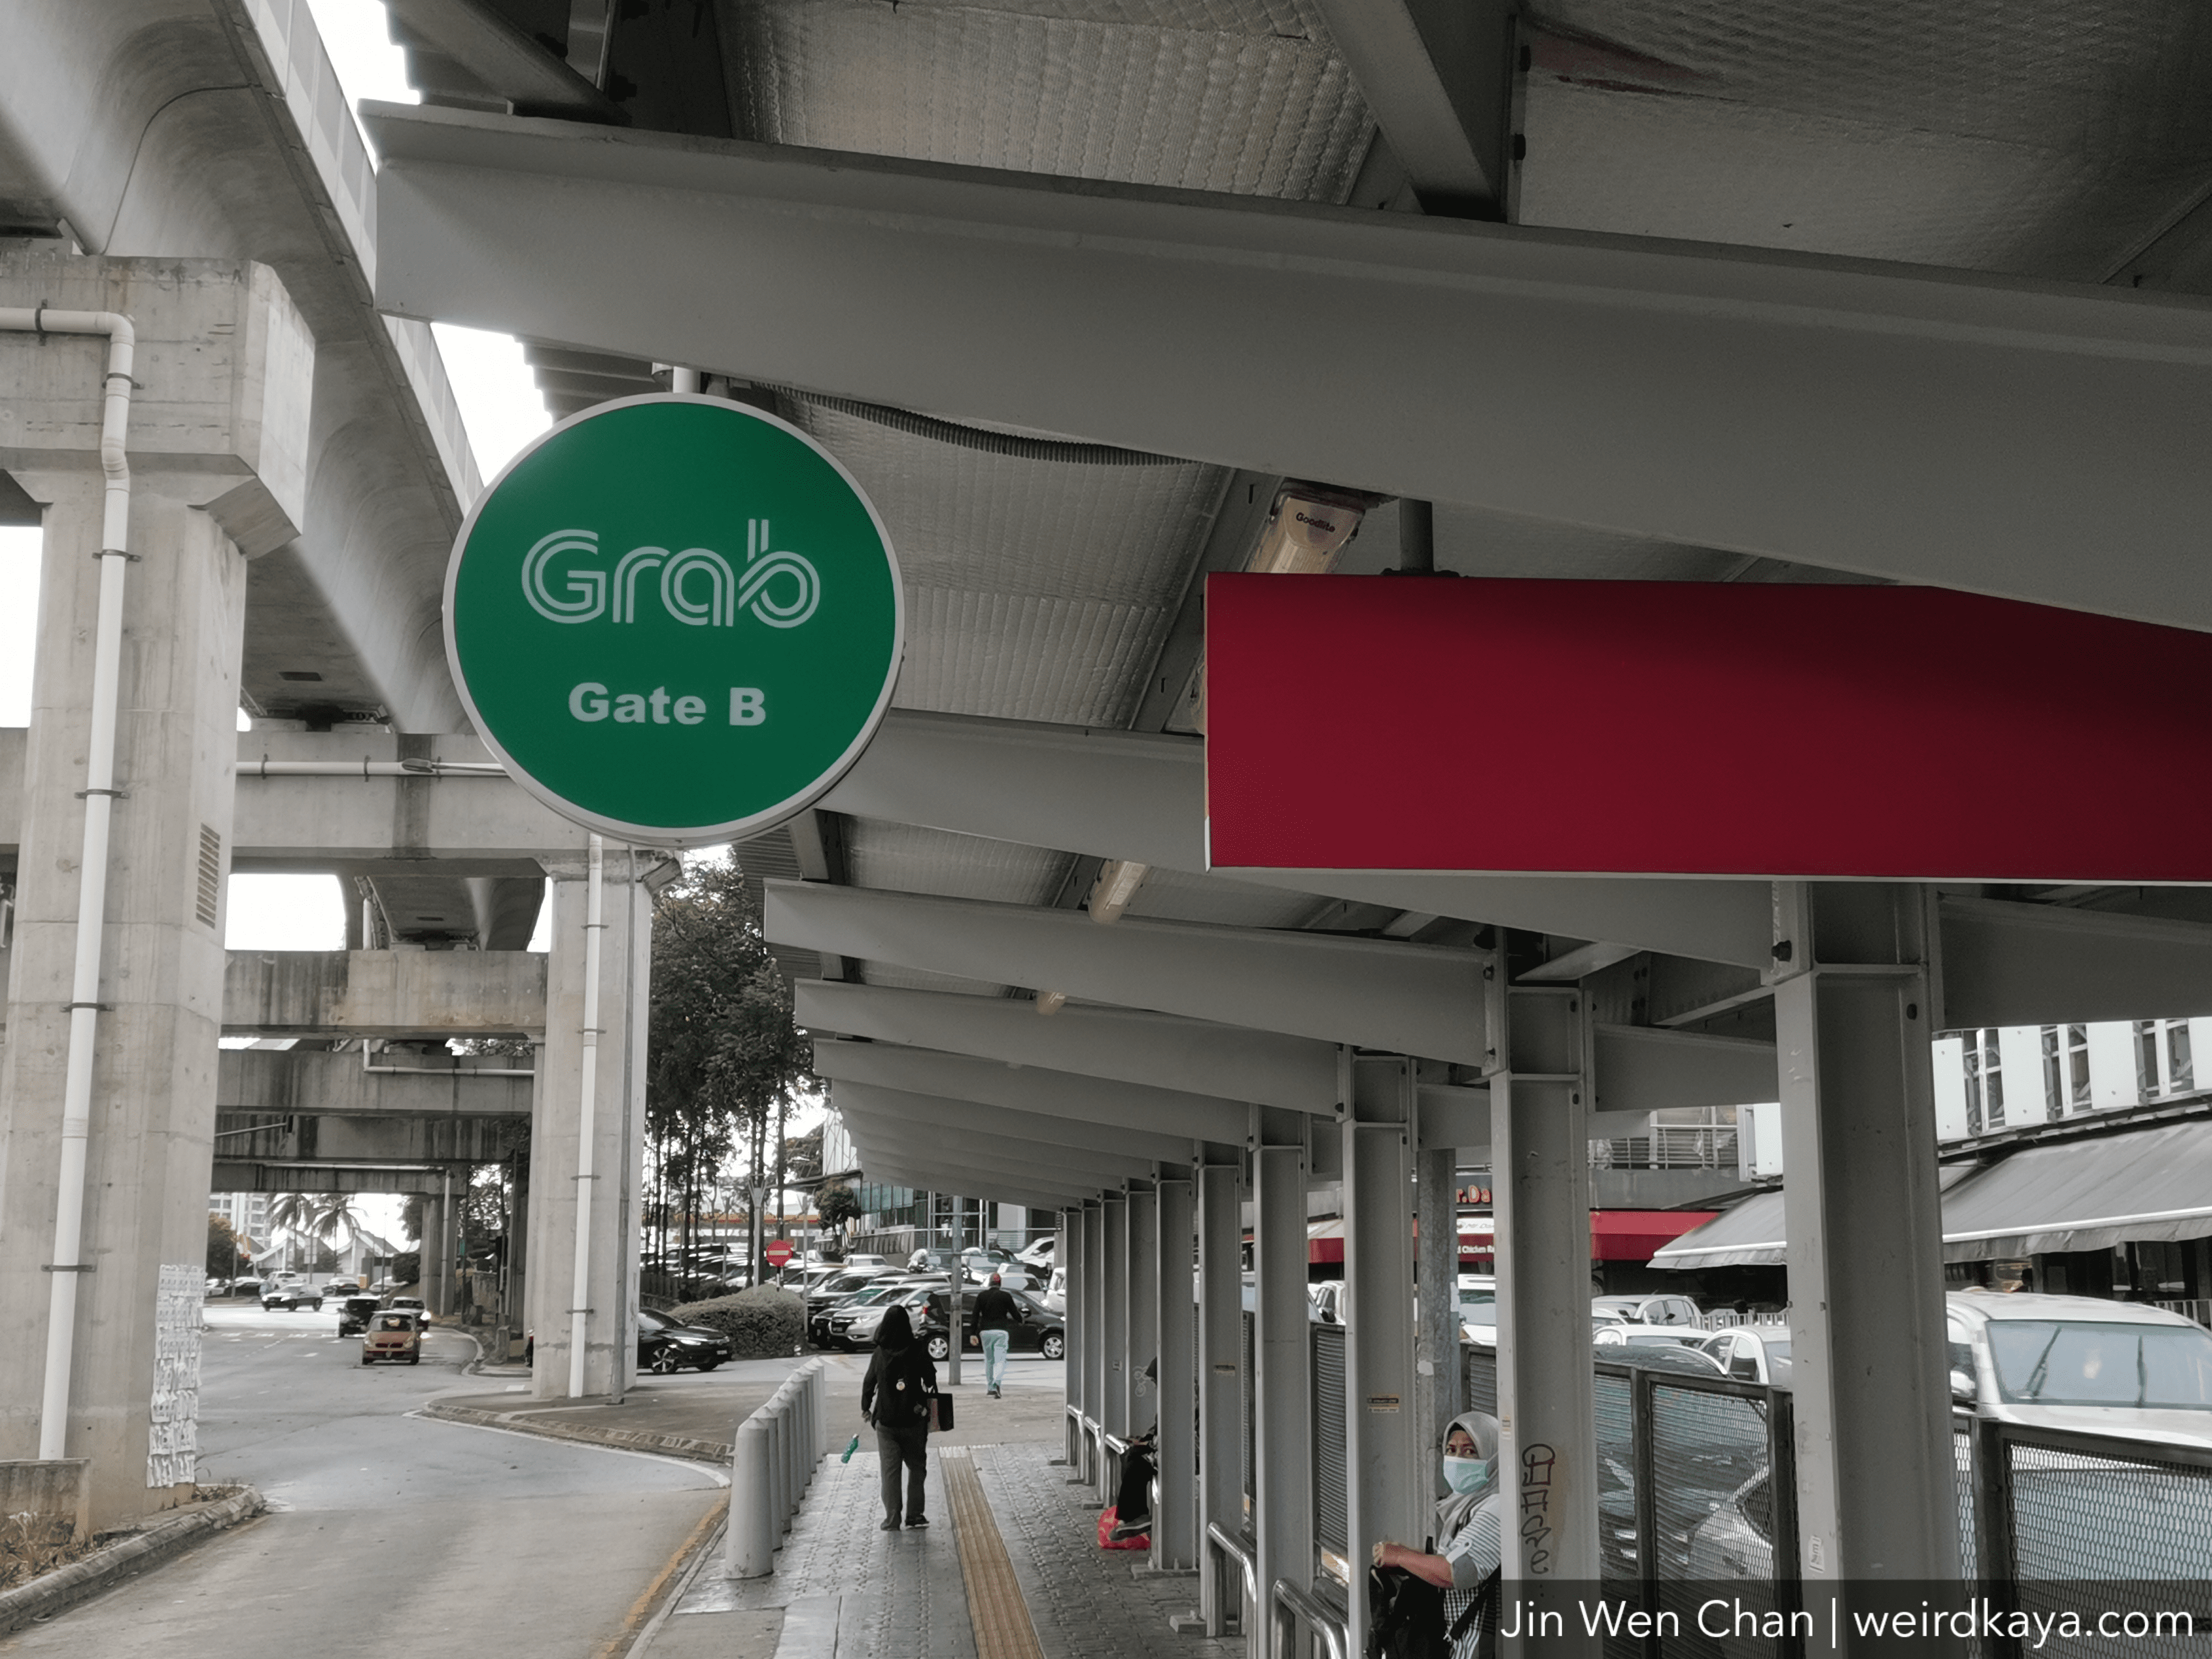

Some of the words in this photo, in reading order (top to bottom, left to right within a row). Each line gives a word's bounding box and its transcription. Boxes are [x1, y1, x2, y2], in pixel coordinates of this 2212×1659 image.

[1296, 512, 1335, 533] Goodlite
[522, 519, 820, 628] Grab
[569, 682, 706, 725] Gate
[729, 687, 766, 726] B
[1456, 1185, 1491, 1203] r.Da
